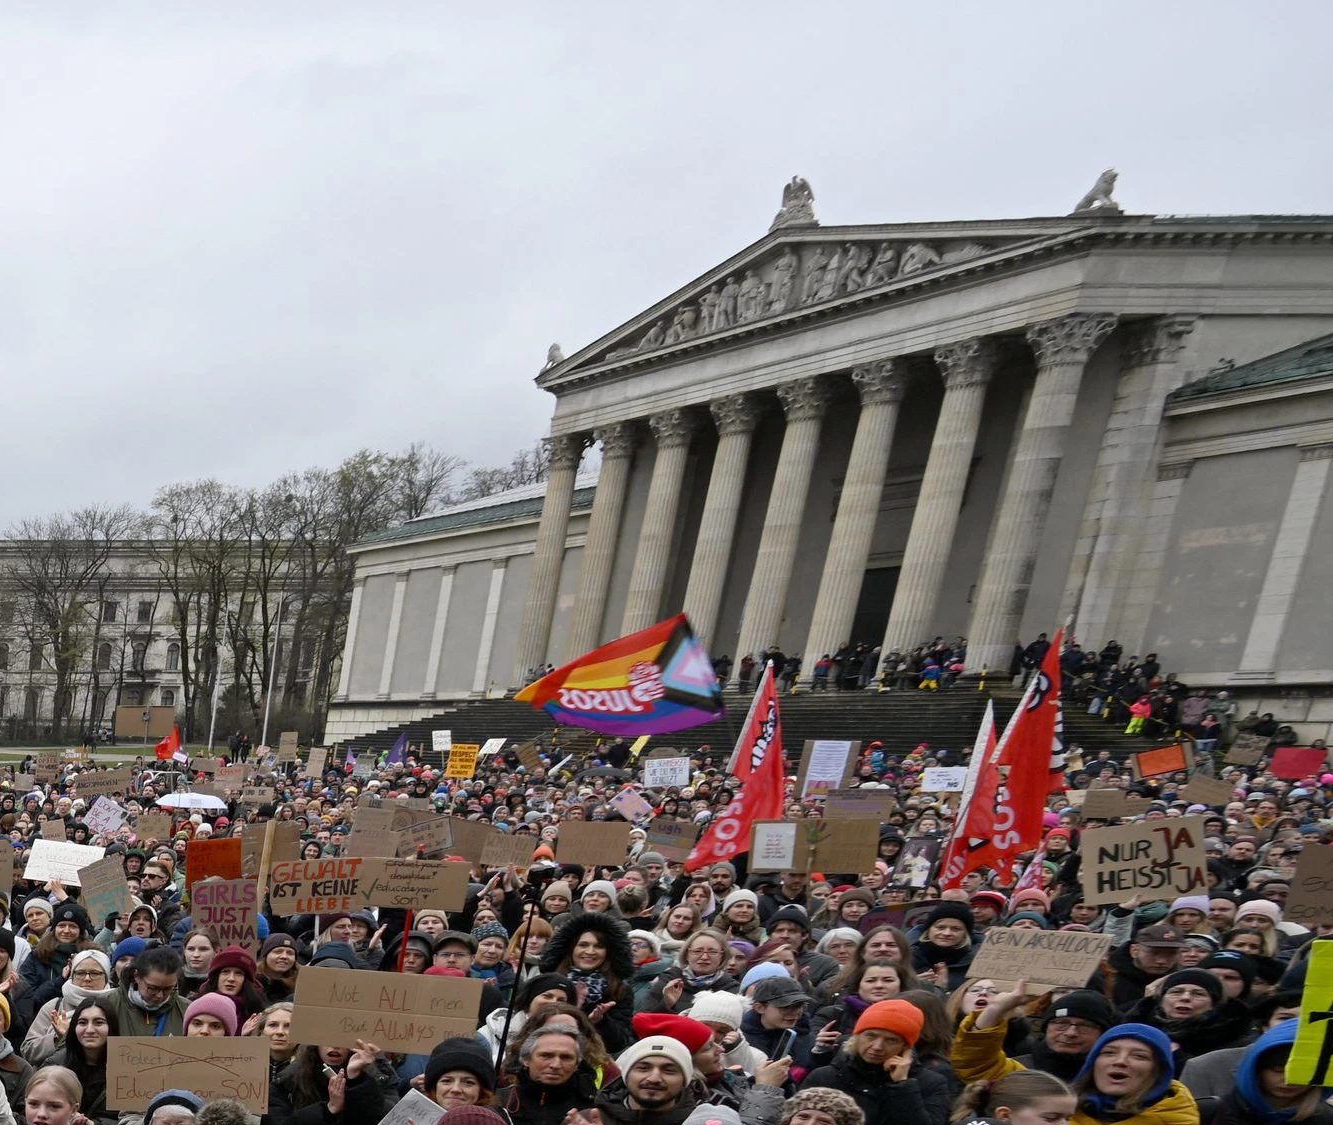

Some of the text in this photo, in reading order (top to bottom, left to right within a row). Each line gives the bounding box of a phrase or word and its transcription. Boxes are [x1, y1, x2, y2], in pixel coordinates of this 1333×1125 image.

[451, 751, 477, 759] RESPECT
[92, 809, 101, 818] BE
[657, 823, 683, 835] ugh
[1098, 827, 1195, 868] NUR JA
[272, 858, 363, 883] GEWALT
[1097, 862, 1206, 894] HEISST JA
[195, 883, 257, 905] GIRLS
[273, 878, 359, 898] IST KEINE
[296, 897, 351, 912] LIEBE
[200, 907, 252, 924] JUST
[986, 932, 1109, 951] KEIN ARSCHLOCH
[331, 985, 464, 1011] Not ALL men
[342, 1017, 369, 1033] But
[117, 1047, 164, 1066] Protect
[222, 1066, 267, 1110] SON!
